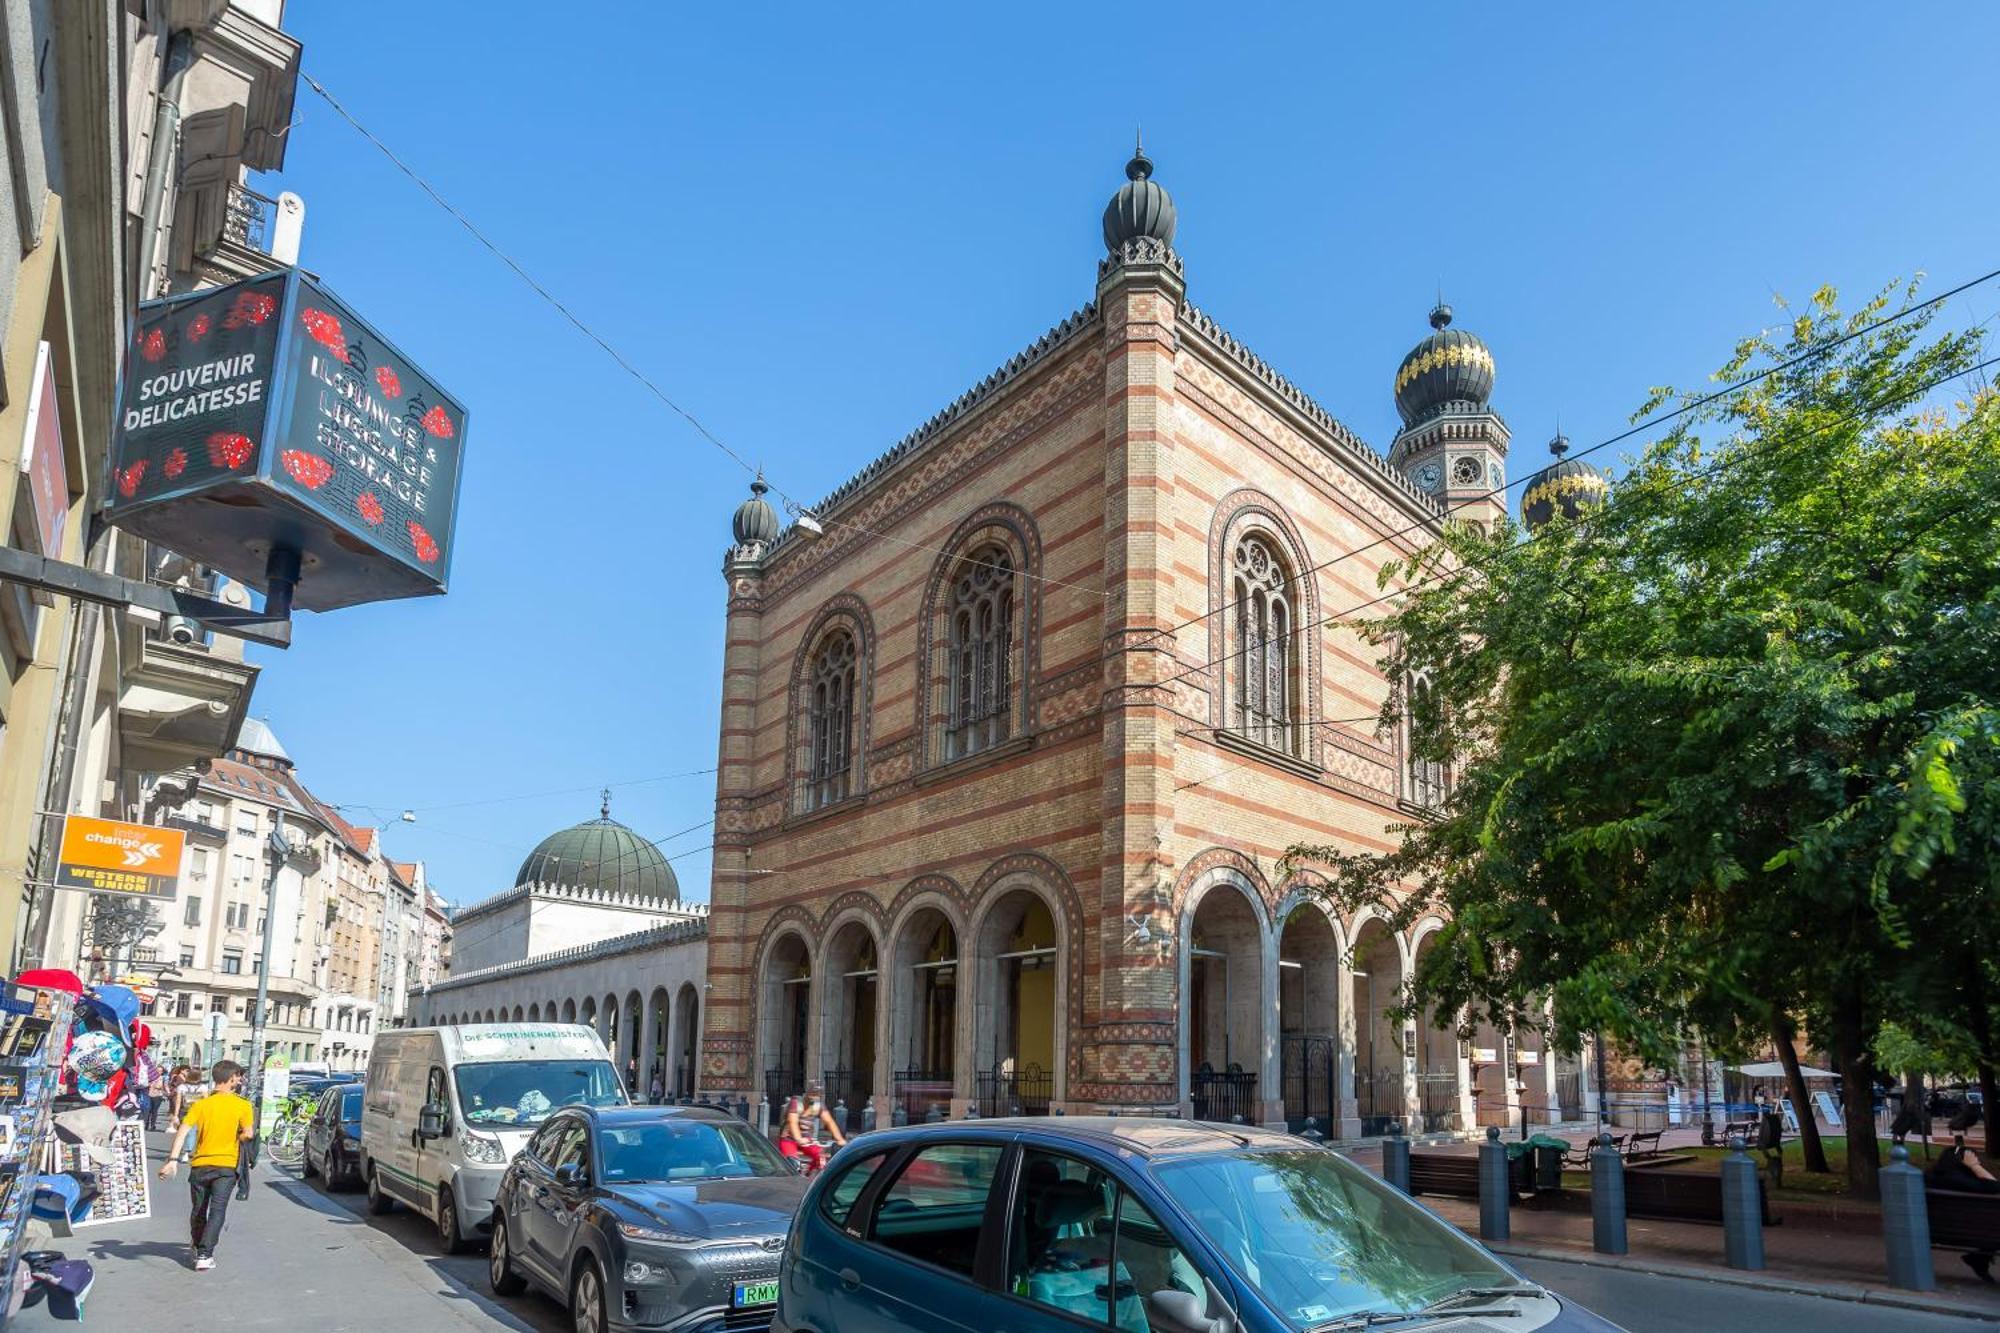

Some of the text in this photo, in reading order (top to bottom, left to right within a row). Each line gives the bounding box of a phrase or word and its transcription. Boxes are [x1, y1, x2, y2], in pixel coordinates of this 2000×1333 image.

[140, 353, 255, 400] SOUVENIR
[124, 379, 262, 431] DELICATESSE
[319, 389, 432, 487] LUGGAGE
[426, 447, 437, 464] &
[316, 422, 426, 512] STORAGE
[85, 833, 140, 849] change
[71, 868, 147, 884] WESTERN
[94, 880, 146, 893] UNION
[747, 1285, 778, 1301] RMY
